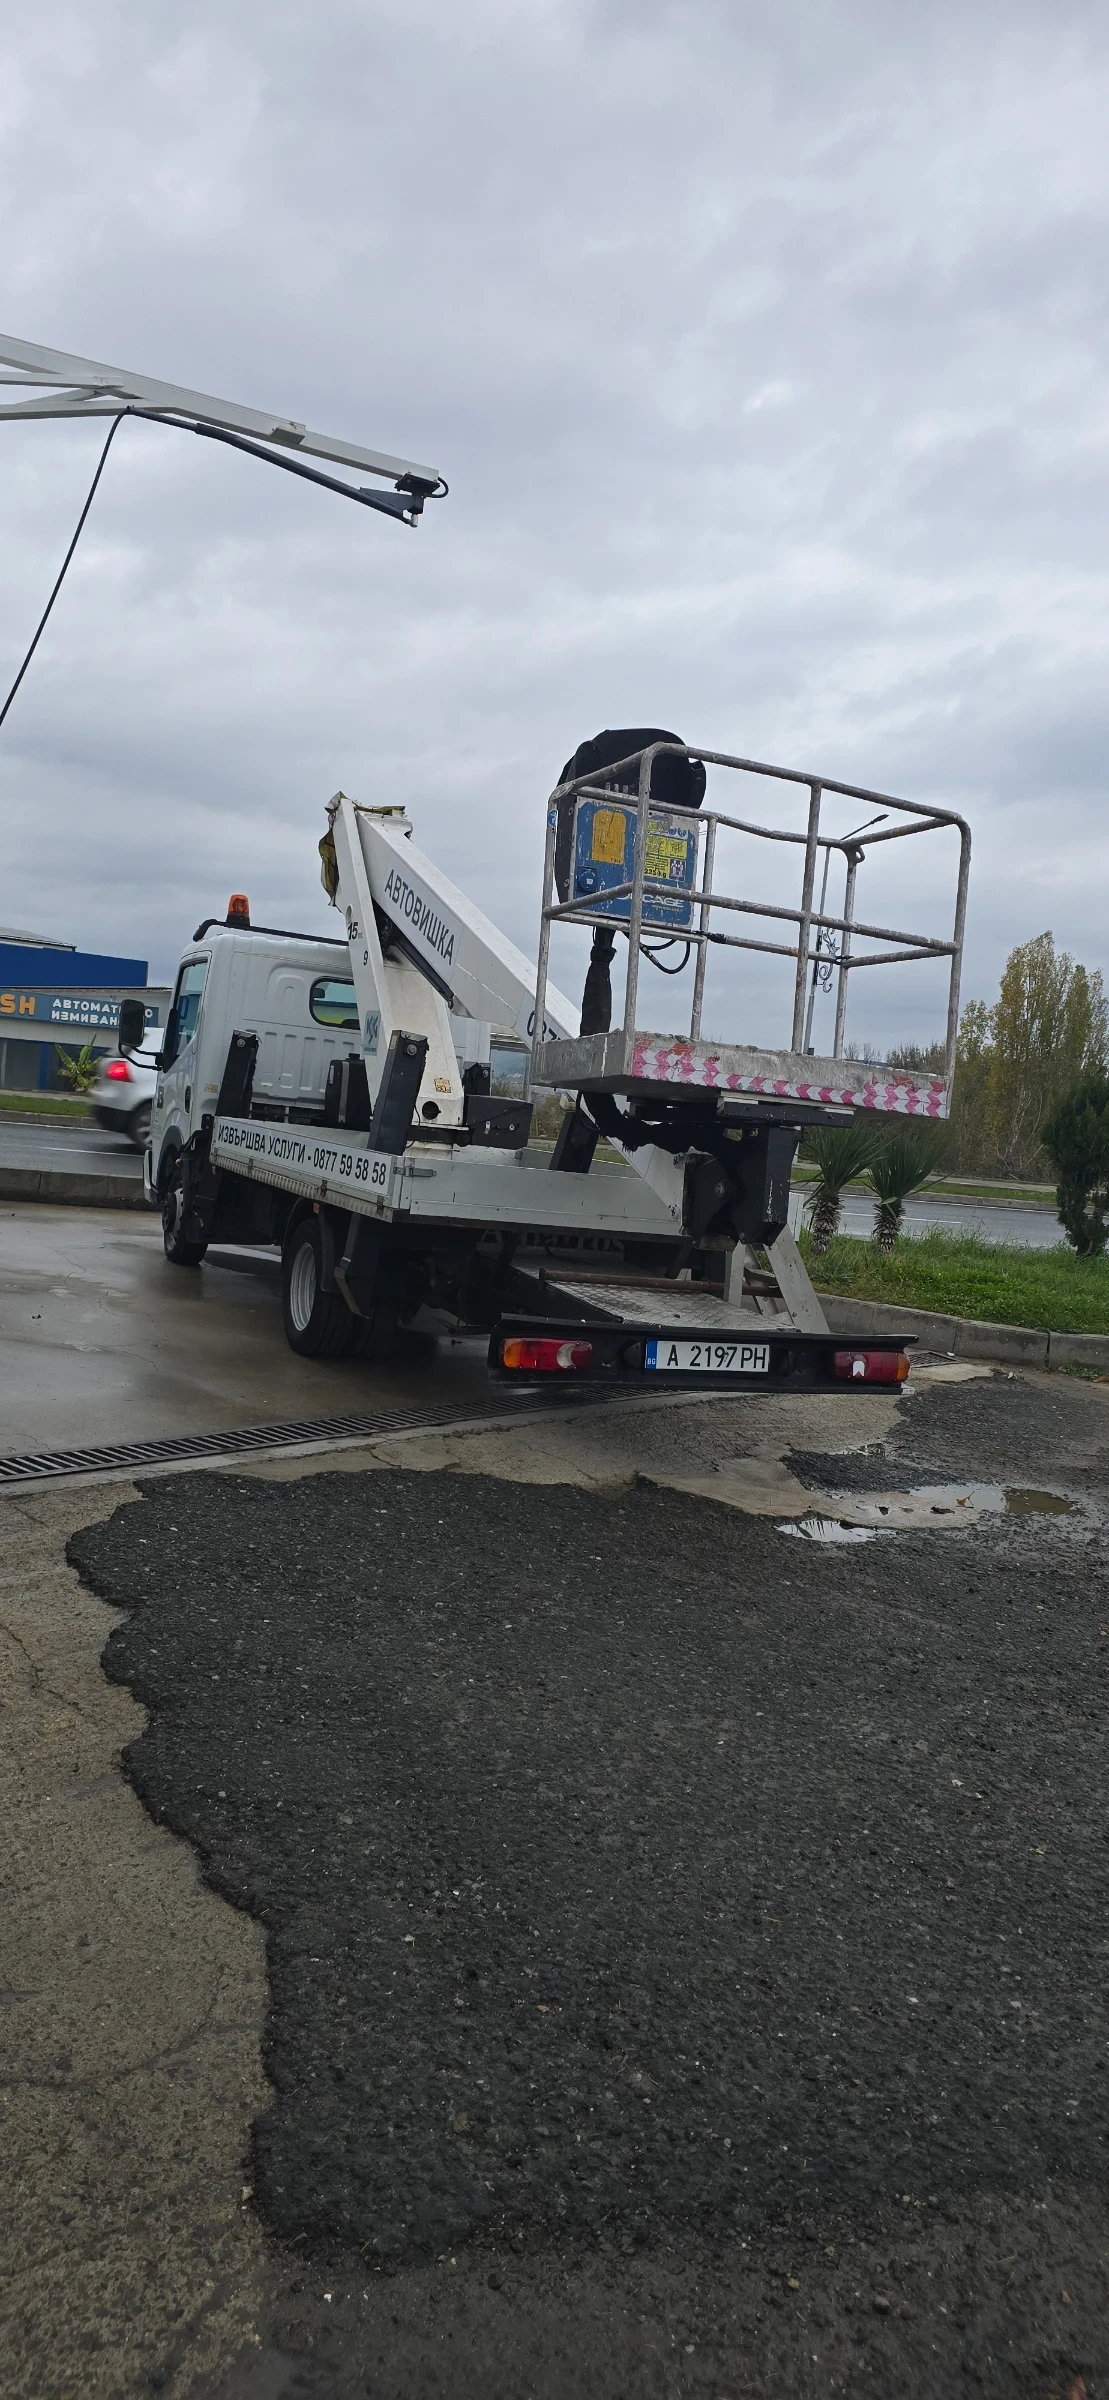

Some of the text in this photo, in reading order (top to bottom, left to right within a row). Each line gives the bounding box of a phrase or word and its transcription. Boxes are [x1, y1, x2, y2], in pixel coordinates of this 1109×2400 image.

[384, 868, 455, 966] АВТОВИШКА
[347, 921, 359, 940] 15
[363, 950, 369, 966] 9
[218, 1124, 266, 1153] ИЗВЪРШВА
[268, 1135, 306, 1163] УСЛУГИ
[313, 1147, 338, 1172] 0877
[339, 1155, 353, 1176] 59
[355, 1157, 369, 1181] 58
[371, 1161, 387, 1186] 58
[667, 1344, 679, 1367] A
[689, 1345, 738, 1368] 2197
[740, 1347, 767, 1369] PH
